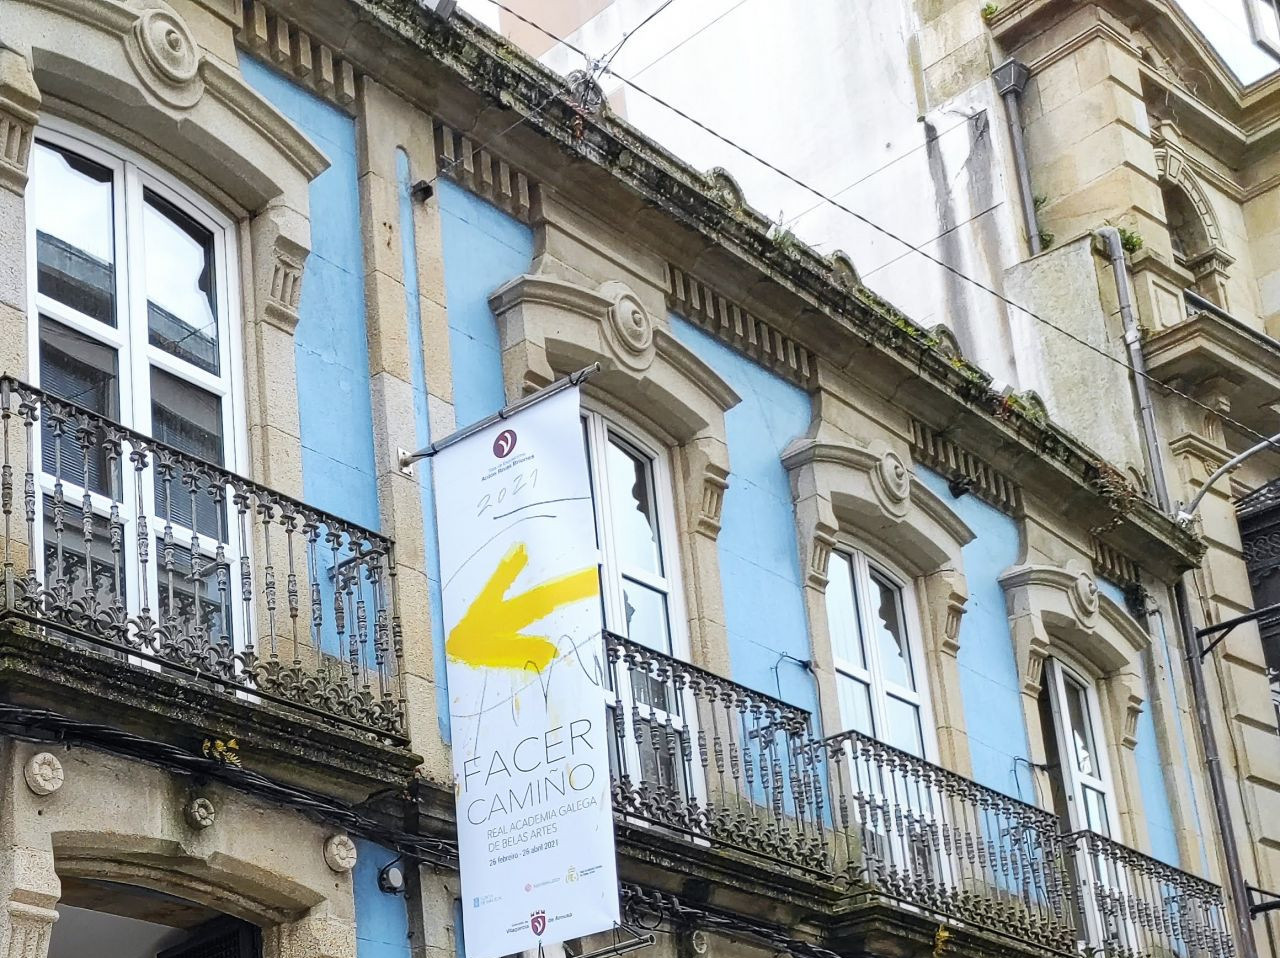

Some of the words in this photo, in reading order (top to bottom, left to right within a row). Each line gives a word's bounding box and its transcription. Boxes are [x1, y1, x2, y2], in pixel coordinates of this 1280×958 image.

[477, 468, 538, 517] 2021
[463, 718, 594, 793] FACER
[467, 763, 595, 825] CAMIÑO
[487, 825, 508, 840] REAL
[510, 809, 558, 833] ACADEMIA
[558, 796, 598, 817] GALEGA
[488, 840, 501, 853] DE
[502, 832, 529, 849] BELAS
[529, 822, 558, 840] ARTES
[531, 844, 543, 854] abril
